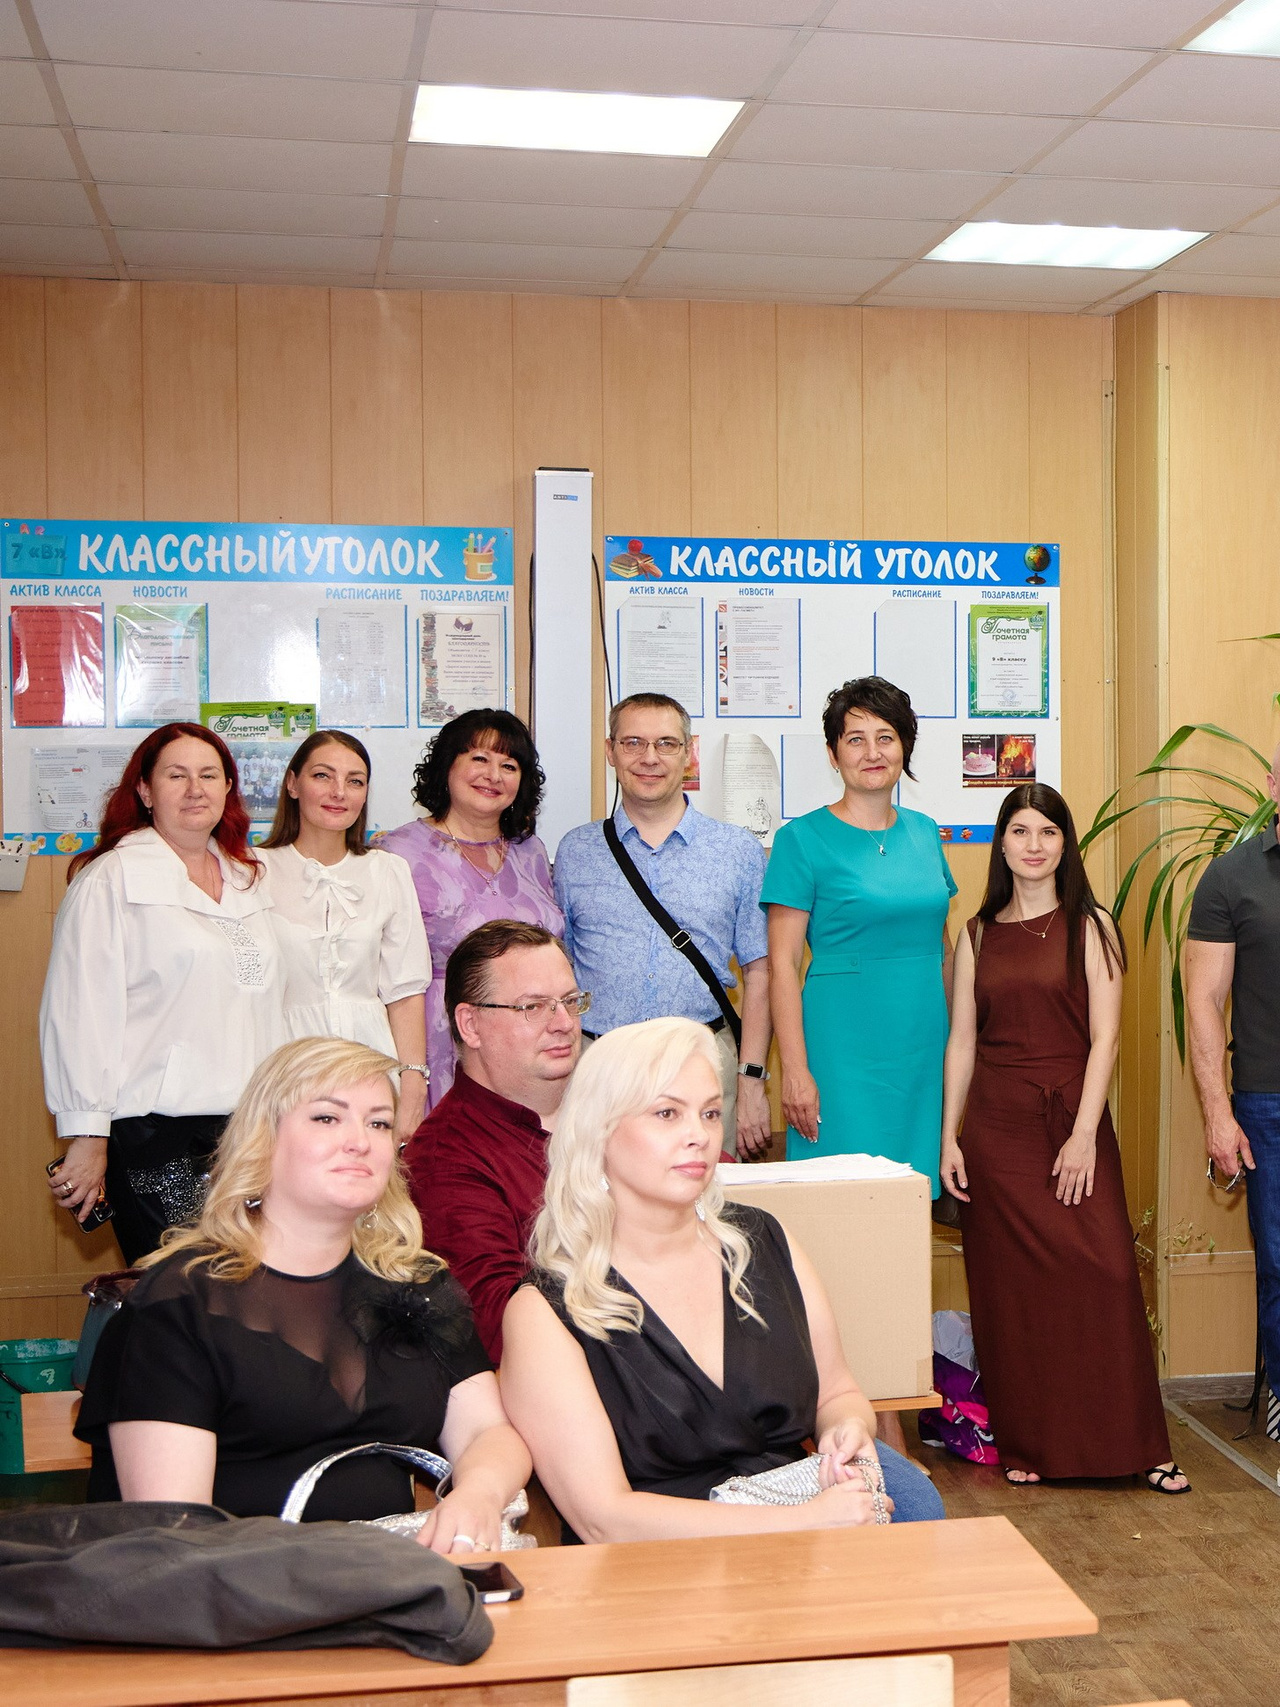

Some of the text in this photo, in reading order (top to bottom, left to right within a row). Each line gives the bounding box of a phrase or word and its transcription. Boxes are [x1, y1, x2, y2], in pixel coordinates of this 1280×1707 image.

[11, 543, 23, 559] 7
[79, 529, 444, 579] КЛАССНЫЙ УГОЛОК
[670, 542, 1001, 582] КЛАССНЫЙ УГОЛОК
[10, 584, 102, 597] АКТИВ КЛАССА
[132, 585, 188, 598] НОВОСТИ
[325, 587, 402, 600] РАСПИСАНИЕ
[420, 589, 510, 602] ПОЗДРАВЛЯЕМ!
[629, 585, 689, 596] АКТИВ КЛАССА
[739, 587, 775, 597] НОВОСТИ
[892, 589, 942, 599] РАСПИСАНИЕ
[981, 590, 1040, 600] ПОЗДРАВЛЯЕМ!
[981, 616, 1030, 635] Почетная
[992, 634, 1027, 642] грамота
